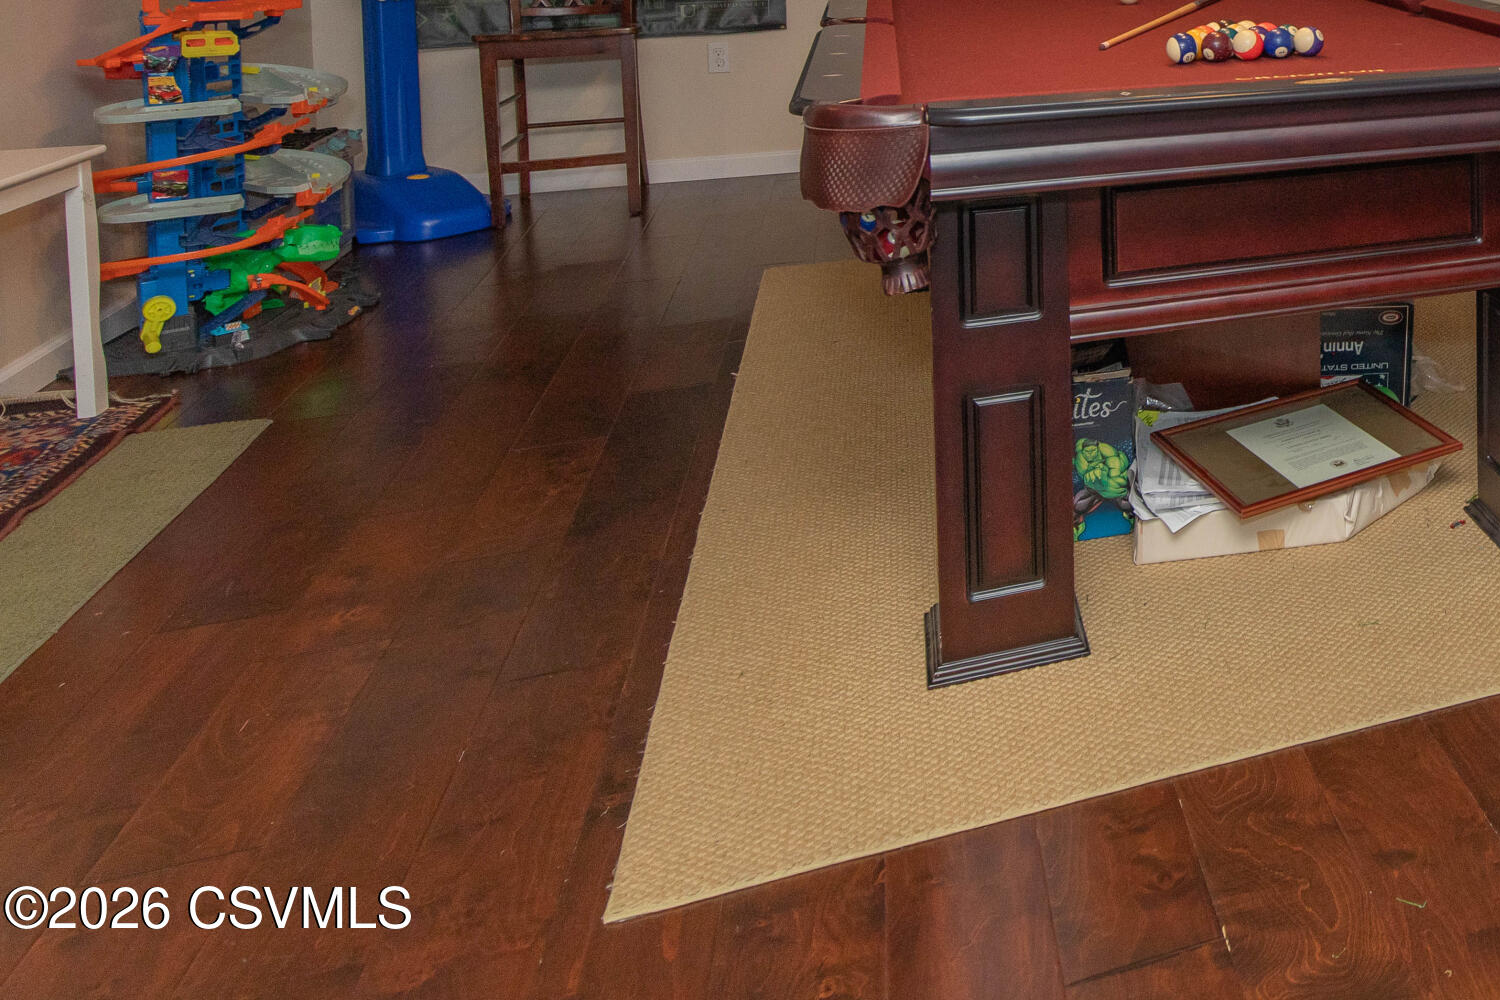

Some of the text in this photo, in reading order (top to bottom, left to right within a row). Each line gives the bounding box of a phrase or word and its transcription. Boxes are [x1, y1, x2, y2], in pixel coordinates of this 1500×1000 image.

[1323, 341, 1364, 355] Annin
[1321, 362, 1389, 372] UNITED STAT
[1072, 387, 1128, 419] ites
